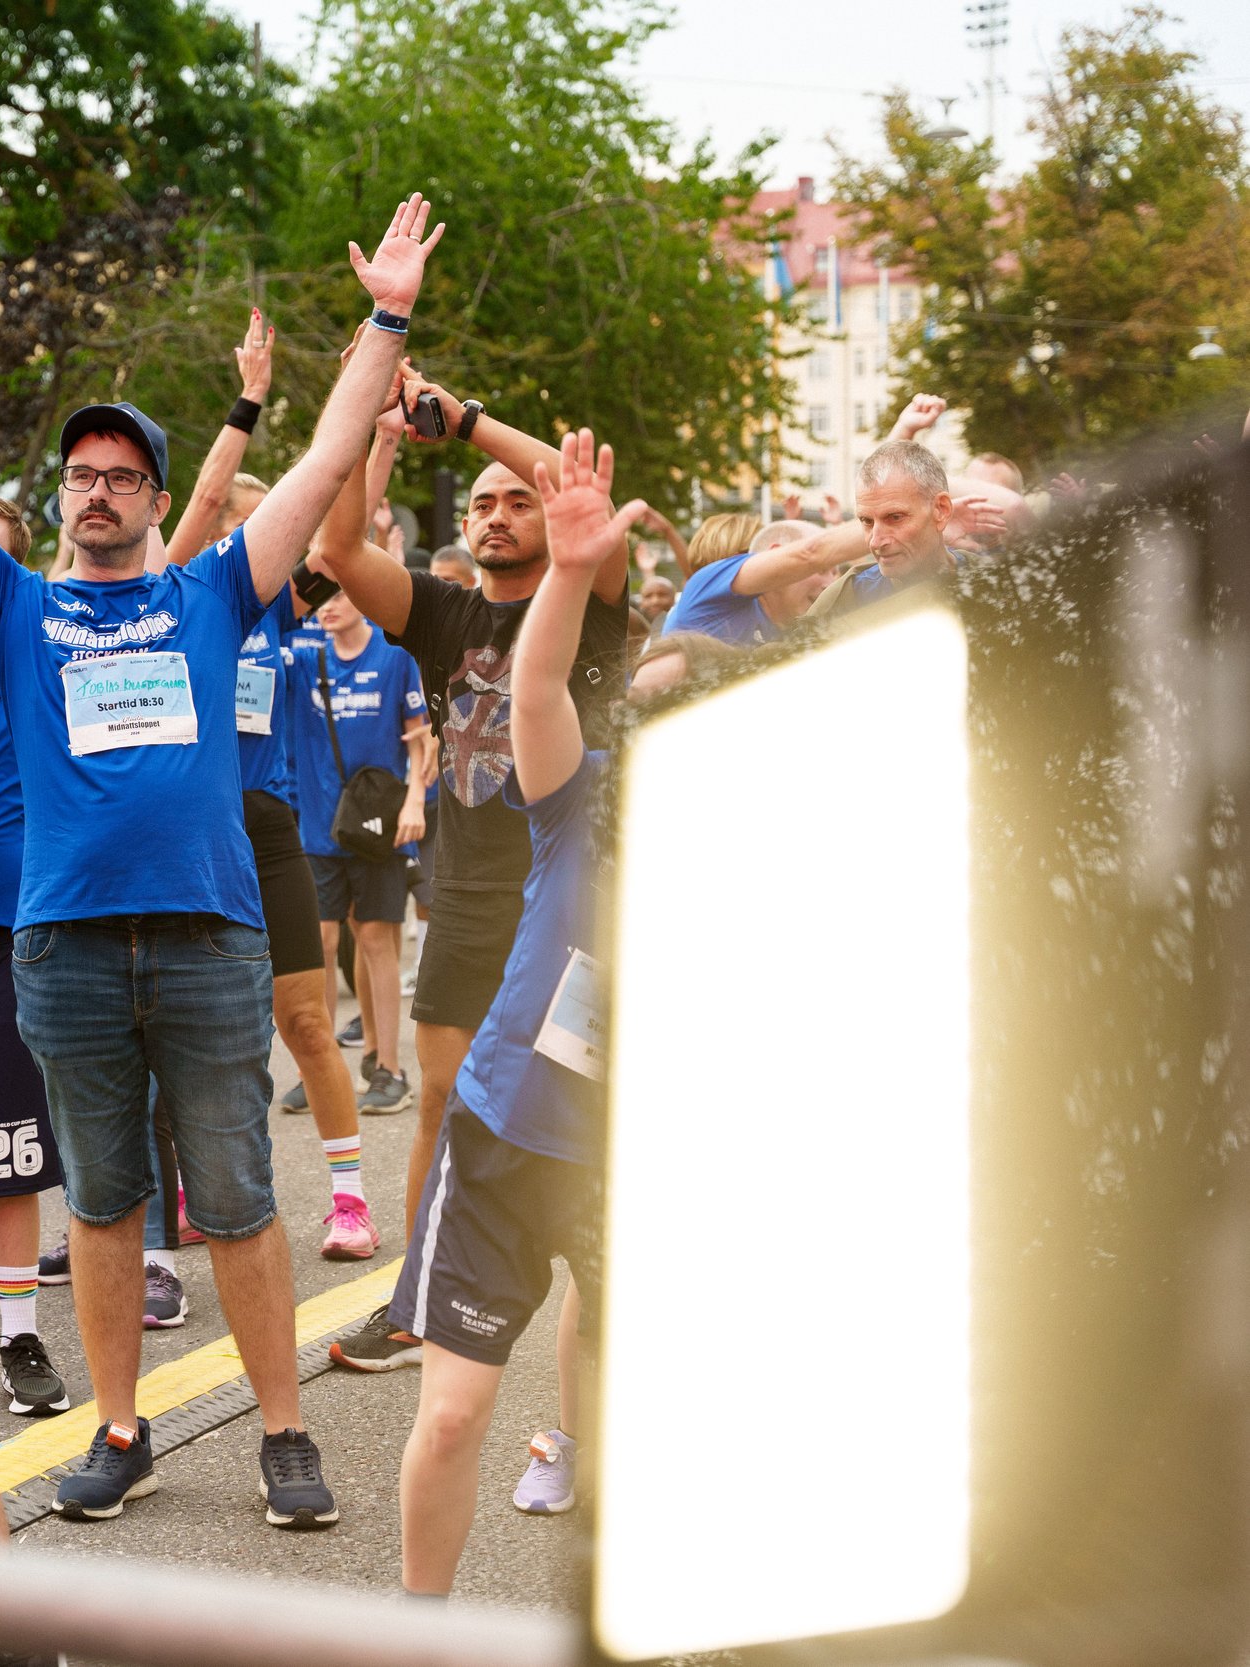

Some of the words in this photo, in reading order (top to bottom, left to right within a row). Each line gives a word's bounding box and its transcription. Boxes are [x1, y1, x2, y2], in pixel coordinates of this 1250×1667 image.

[52, 596, 95, 617] tadium
[97, 697, 137, 712] Starttid
[139, 697, 164, 707] 18:30
[108, 721, 160, 732] Midnattsloppet
[451, 1300, 478, 1318] GLADA
[462, 1315, 498, 1333] TEATERN
